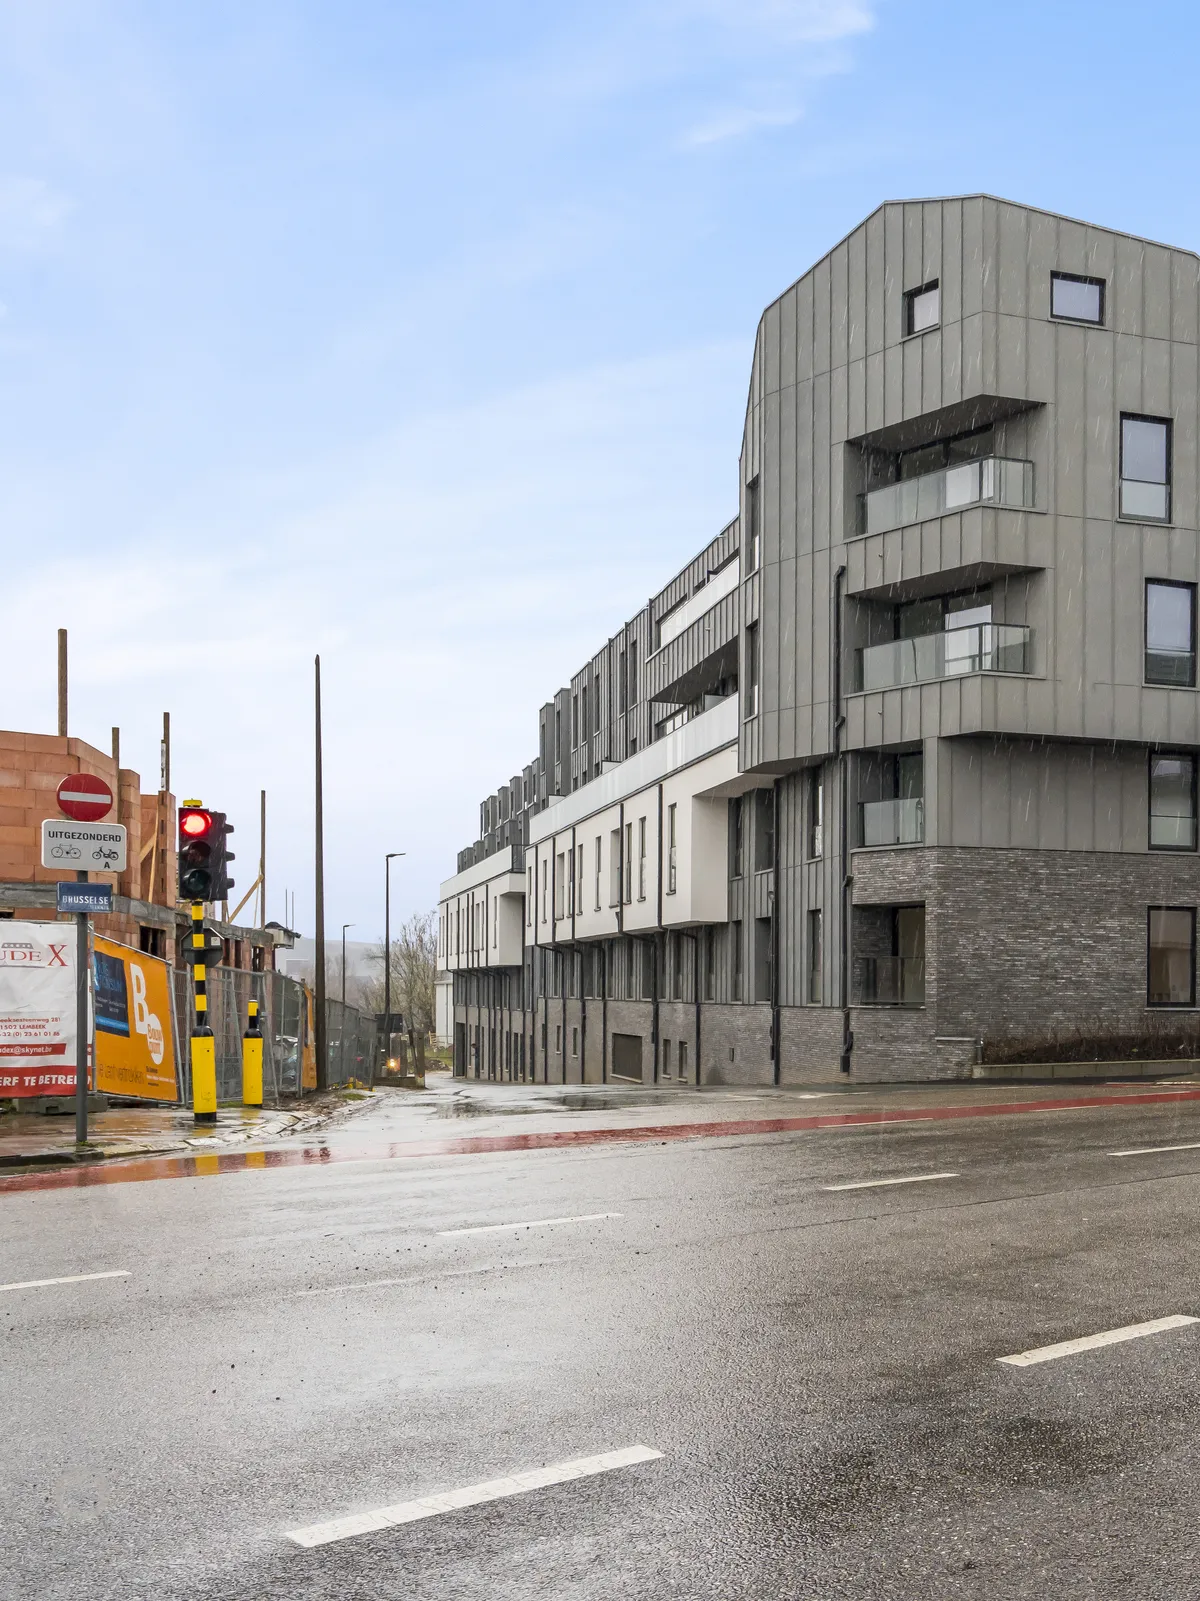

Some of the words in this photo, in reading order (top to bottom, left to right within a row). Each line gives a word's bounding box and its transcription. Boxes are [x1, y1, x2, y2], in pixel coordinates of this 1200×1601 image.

[48, 831, 121, 842] UITGEZONDERD
[104, 861, 111, 869] A
[62, 895, 109, 905] BRUSSELSE
[24, 1076, 37, 1087] TE
